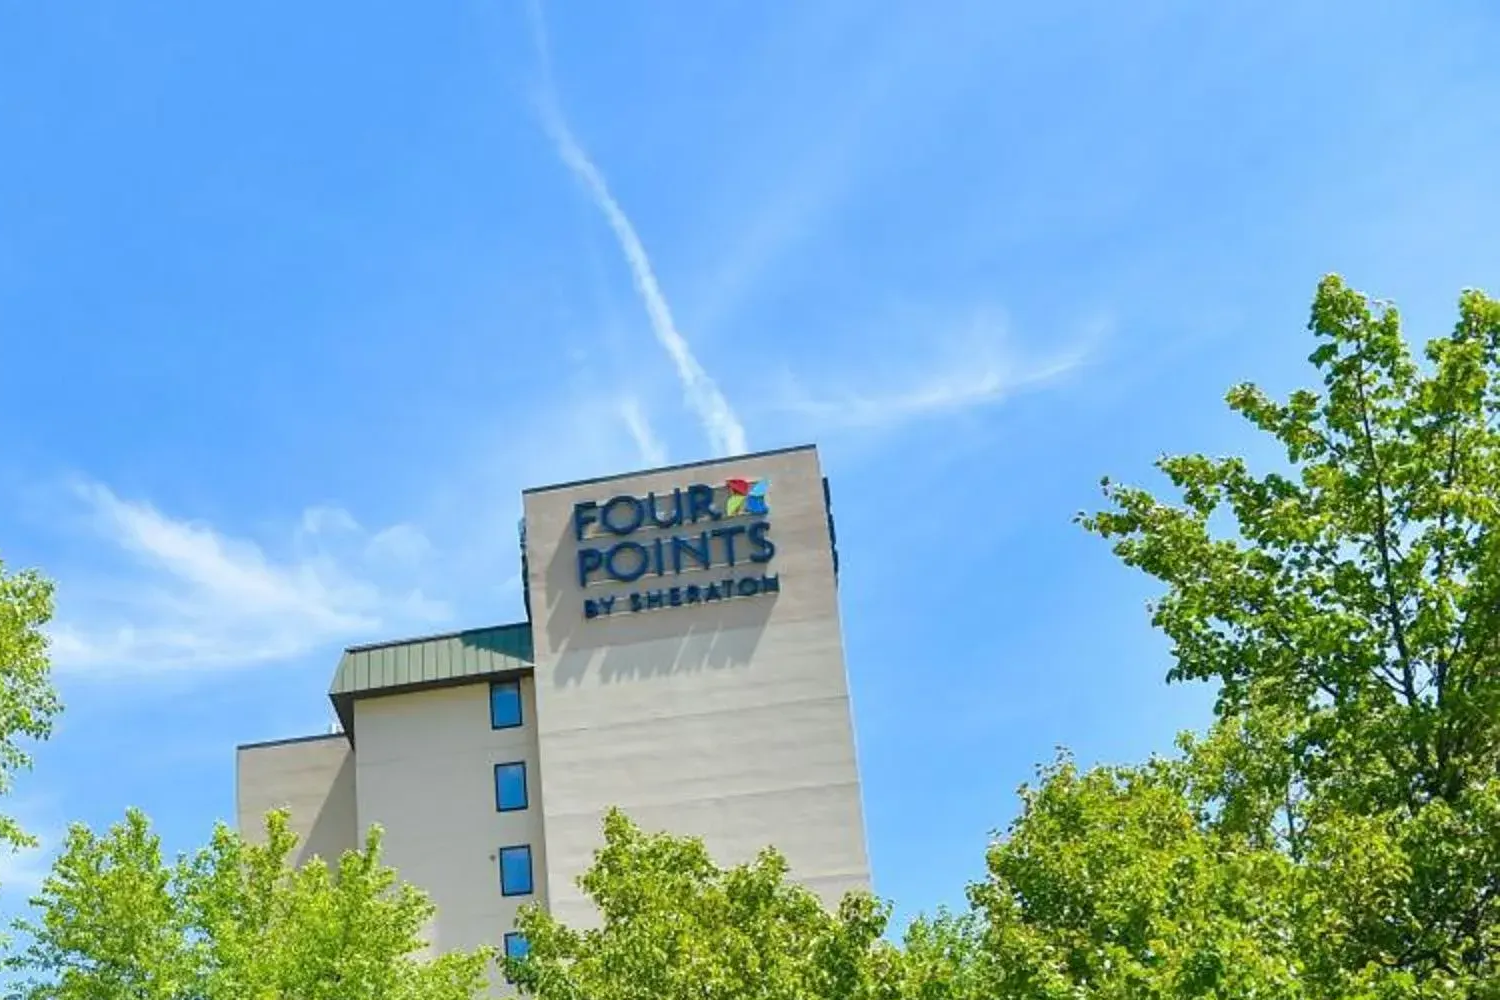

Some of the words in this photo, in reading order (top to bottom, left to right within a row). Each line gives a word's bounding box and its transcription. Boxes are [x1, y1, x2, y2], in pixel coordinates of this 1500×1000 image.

[574, 483, 722, 541] FOUR
[577, 521, 775, 588] POINTS
[584, 597, 615, 619] BY
[629, 572, 780, 613] SHERATON
